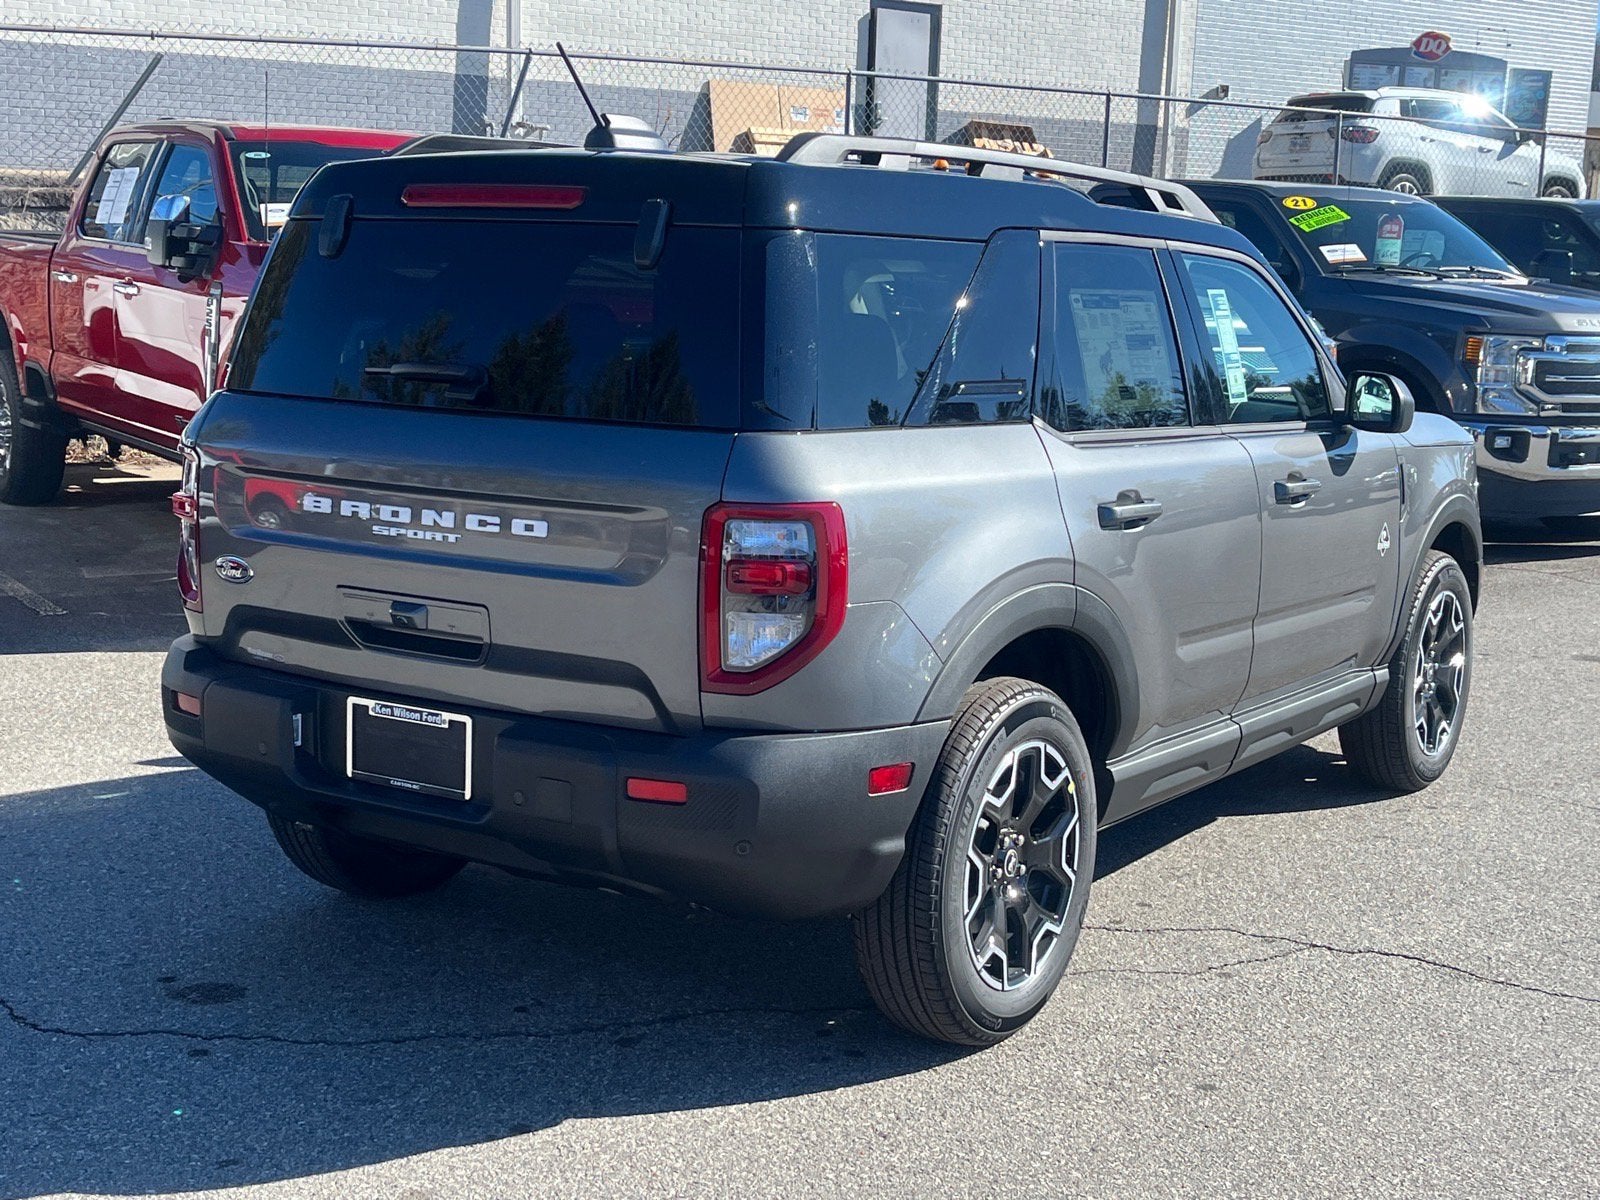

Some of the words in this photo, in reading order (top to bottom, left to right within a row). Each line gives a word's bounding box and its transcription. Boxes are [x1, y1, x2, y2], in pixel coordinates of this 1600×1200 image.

[1419, 38, 1448, 55] DQ
[1290, 198, 1308, 207] 21
[1294, 207, 1336, 223] REDUCED
[302, 495, 549, 538] BRONCO
[372, 525, 462, 543] SPORT
[375, 704, 391, 715] Ken
[393, 707, 421, 720] Wilson
[422, 712, 441, 724] Ford
